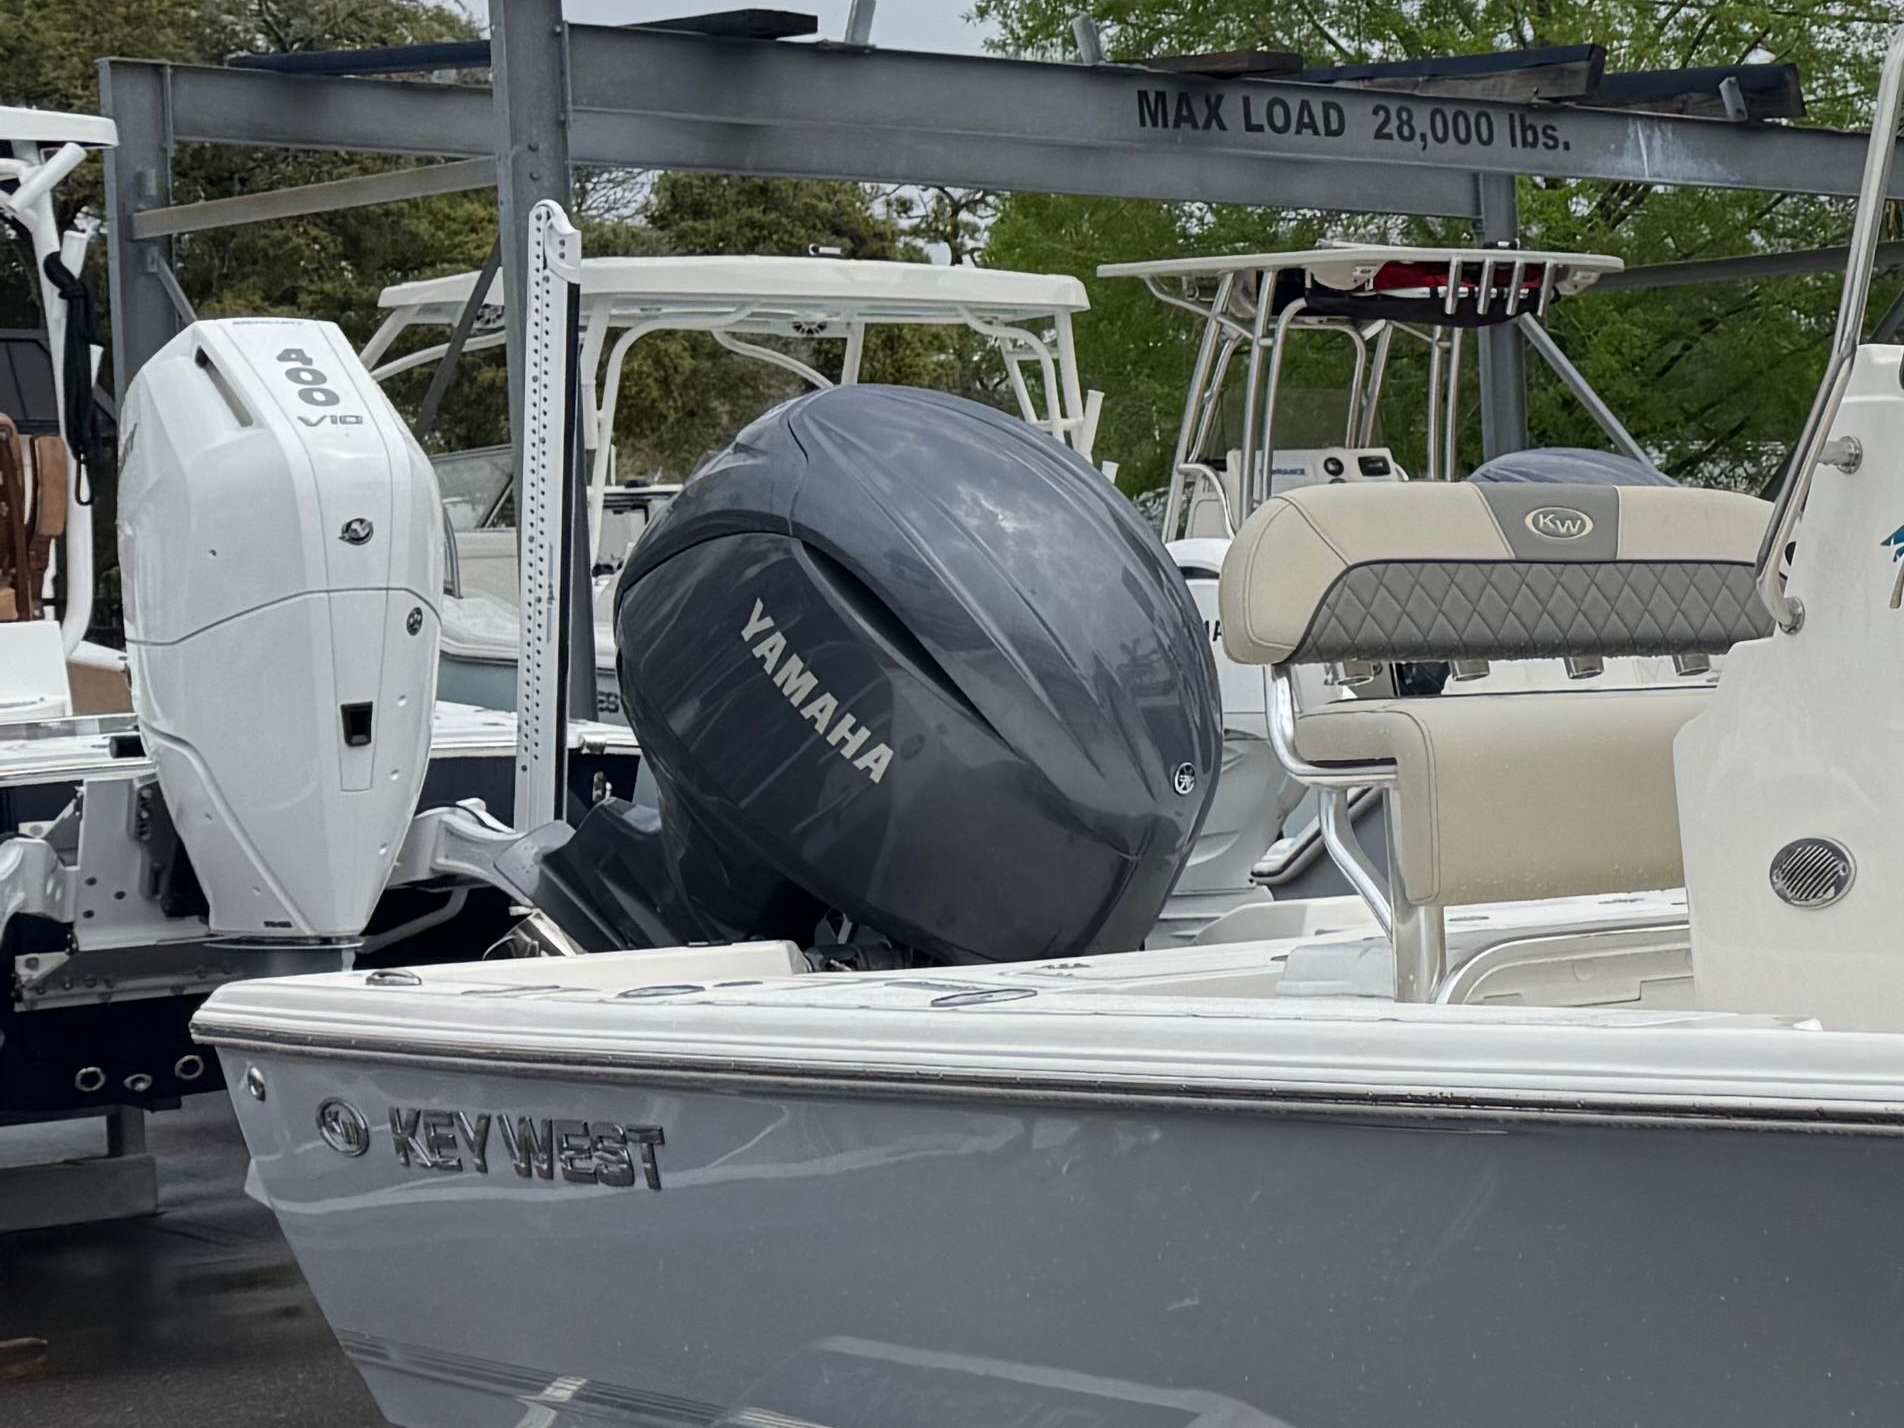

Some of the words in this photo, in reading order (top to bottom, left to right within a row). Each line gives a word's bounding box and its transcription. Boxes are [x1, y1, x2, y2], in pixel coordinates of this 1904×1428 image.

[1137, 89, 1228, 132] MAX
[1243, 95, 1346, 138] LOAD
[1371, 103, 1495, 151] 28,000
[1508, 112, 1571, 152] lbs.
[297, 414, 364, 427] V10
[741, 597, 894, 784] YAMAHA
[388, 1106, 492, 1174] KEY
[496, 1113, 666, 1191] WEST
